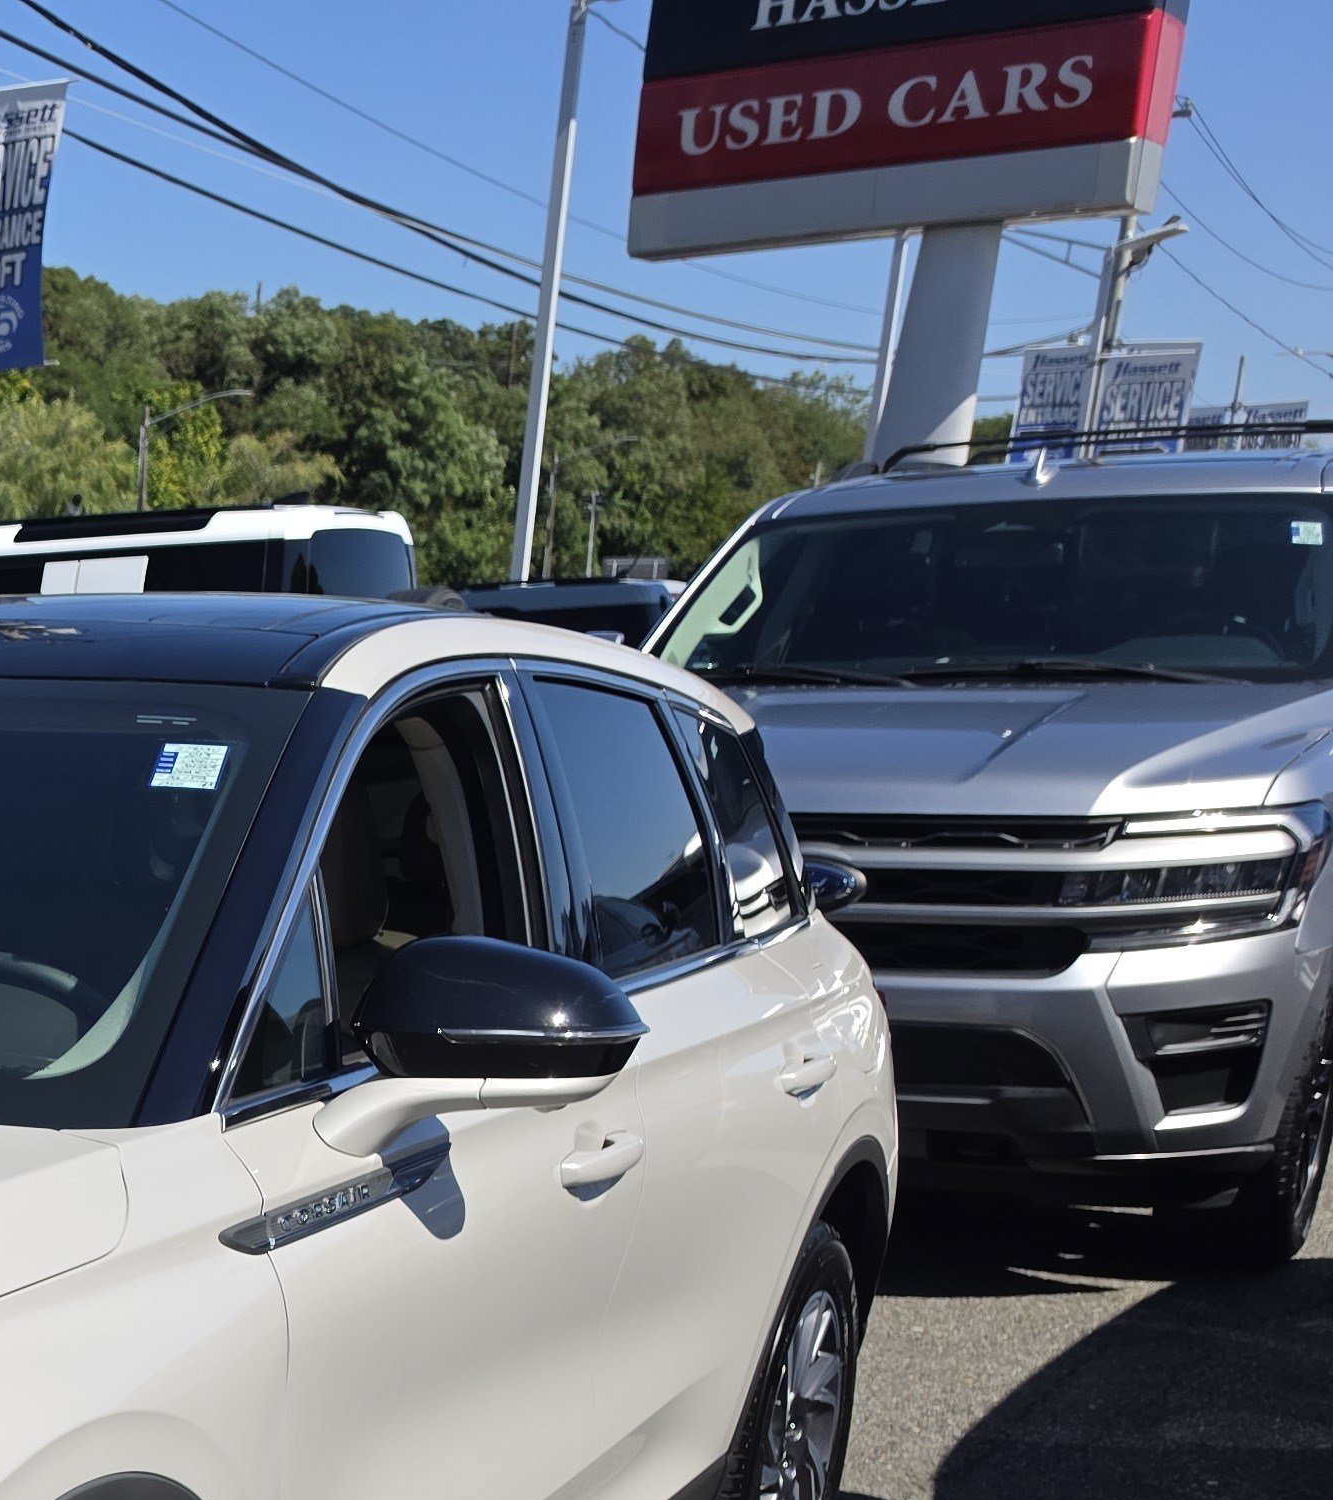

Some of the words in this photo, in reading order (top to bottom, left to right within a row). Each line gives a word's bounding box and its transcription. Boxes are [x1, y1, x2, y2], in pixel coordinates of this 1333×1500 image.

[677, 88, 862, 156] USED
[887, 55, 1095, 128] CARS
[1023, 371, 1085, 406] SERVIC
[1102, 381, 1185, 422] SERVICE
[277, 1183, 371, 1232] CORSAIR
